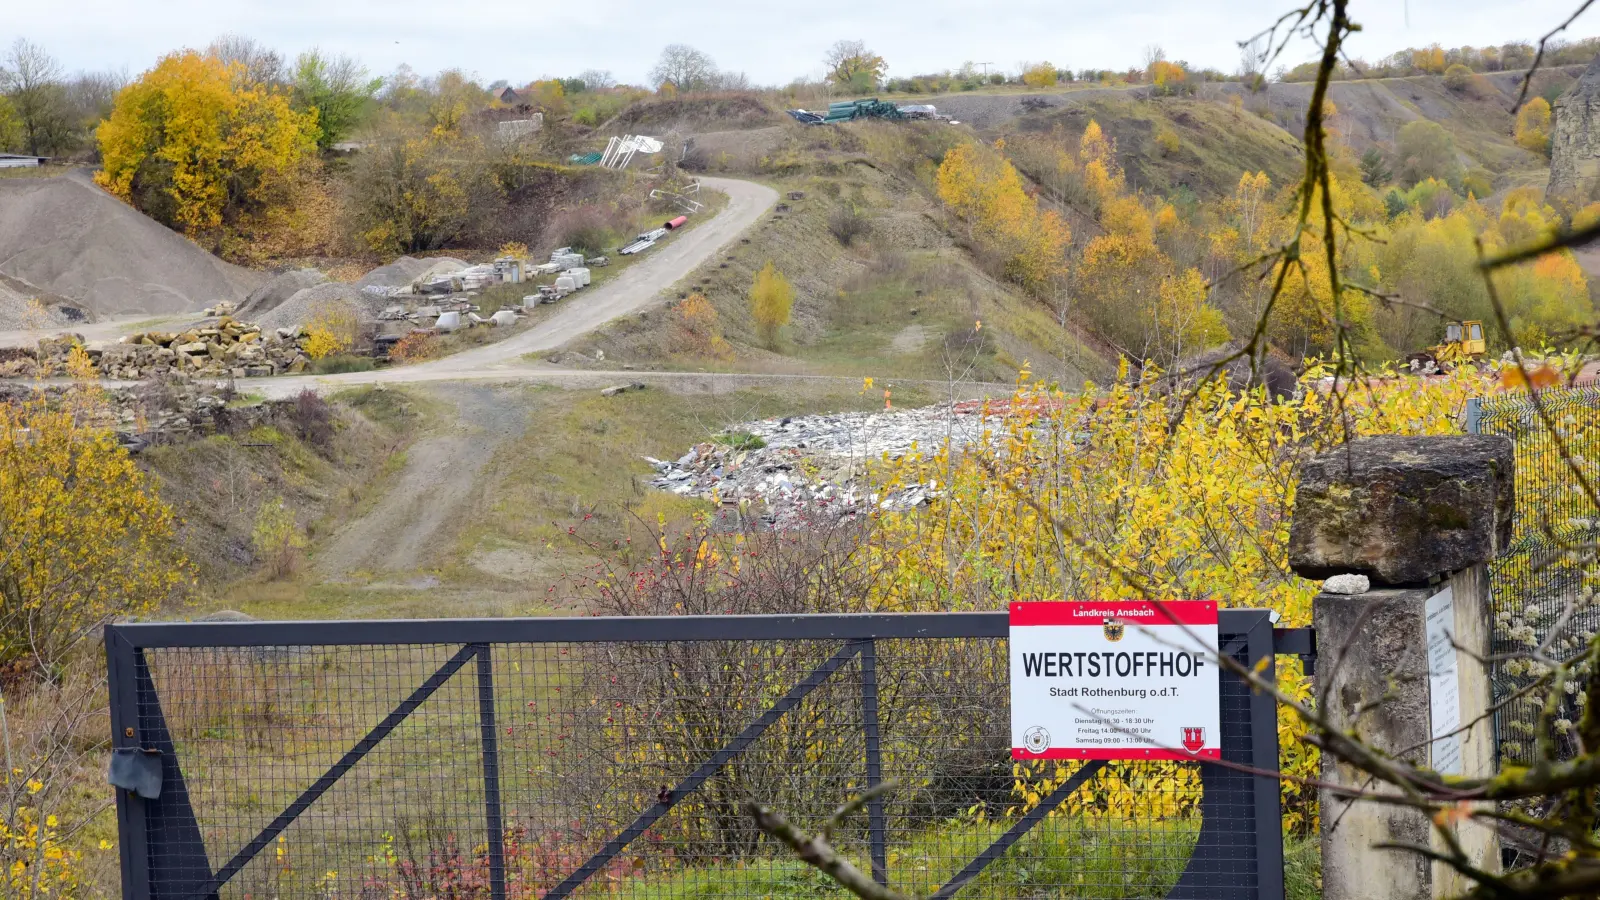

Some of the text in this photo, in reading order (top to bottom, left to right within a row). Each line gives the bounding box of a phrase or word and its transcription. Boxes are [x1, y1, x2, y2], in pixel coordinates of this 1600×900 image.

[1073, 609, 1154, 617] Landkreis Ansbach
[1022, 652, 1205, 677] WERTSTOFFHOF
[1049, 687, 1179, 699] Stadt Rothenburg o.d.T.
